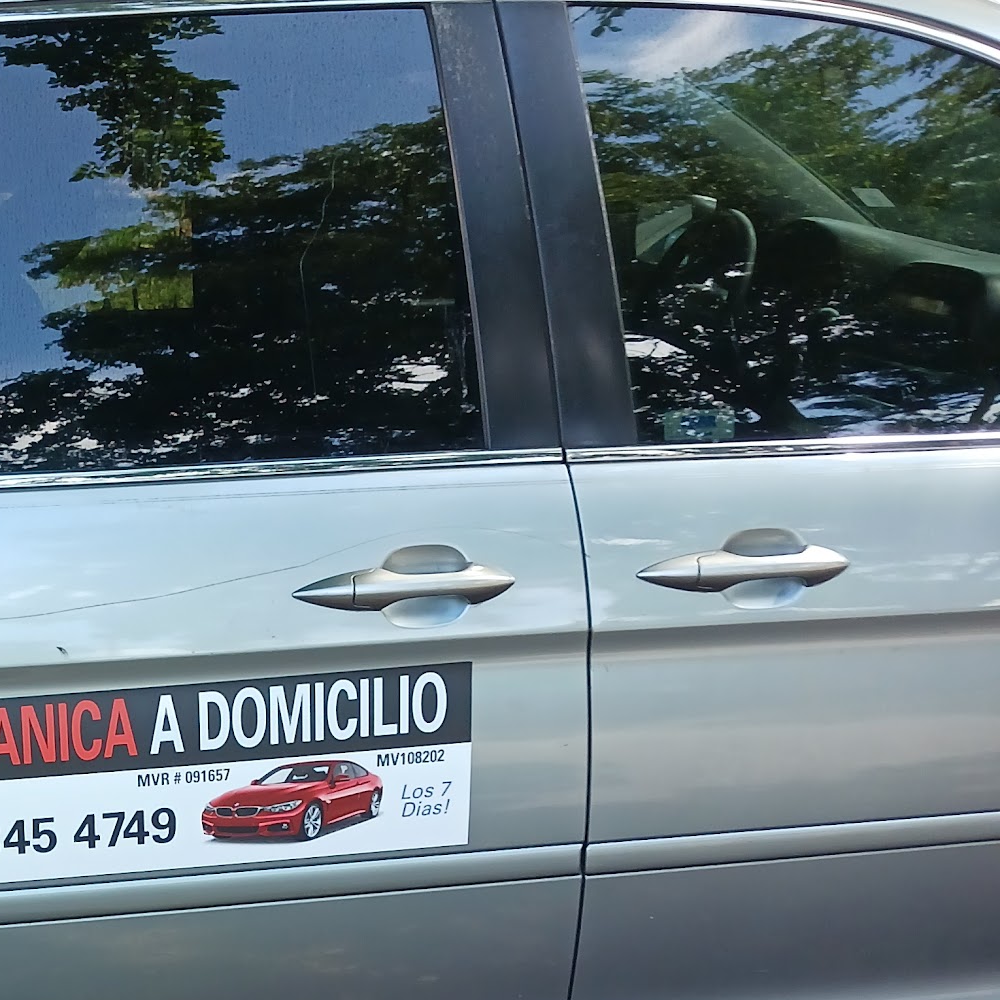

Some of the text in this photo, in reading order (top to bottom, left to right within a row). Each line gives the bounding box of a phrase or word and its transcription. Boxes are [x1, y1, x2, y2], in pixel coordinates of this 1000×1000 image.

[150, 693, 184, 755] A
[198, 671, 448, 752] DOMICILIO
[376, 749, 446, 768] MV108202
[137, 768, 231, 788] MVR # 091657
[401, 781, 452, 801] Los 7
[73, 807, 178, 850] 4749
